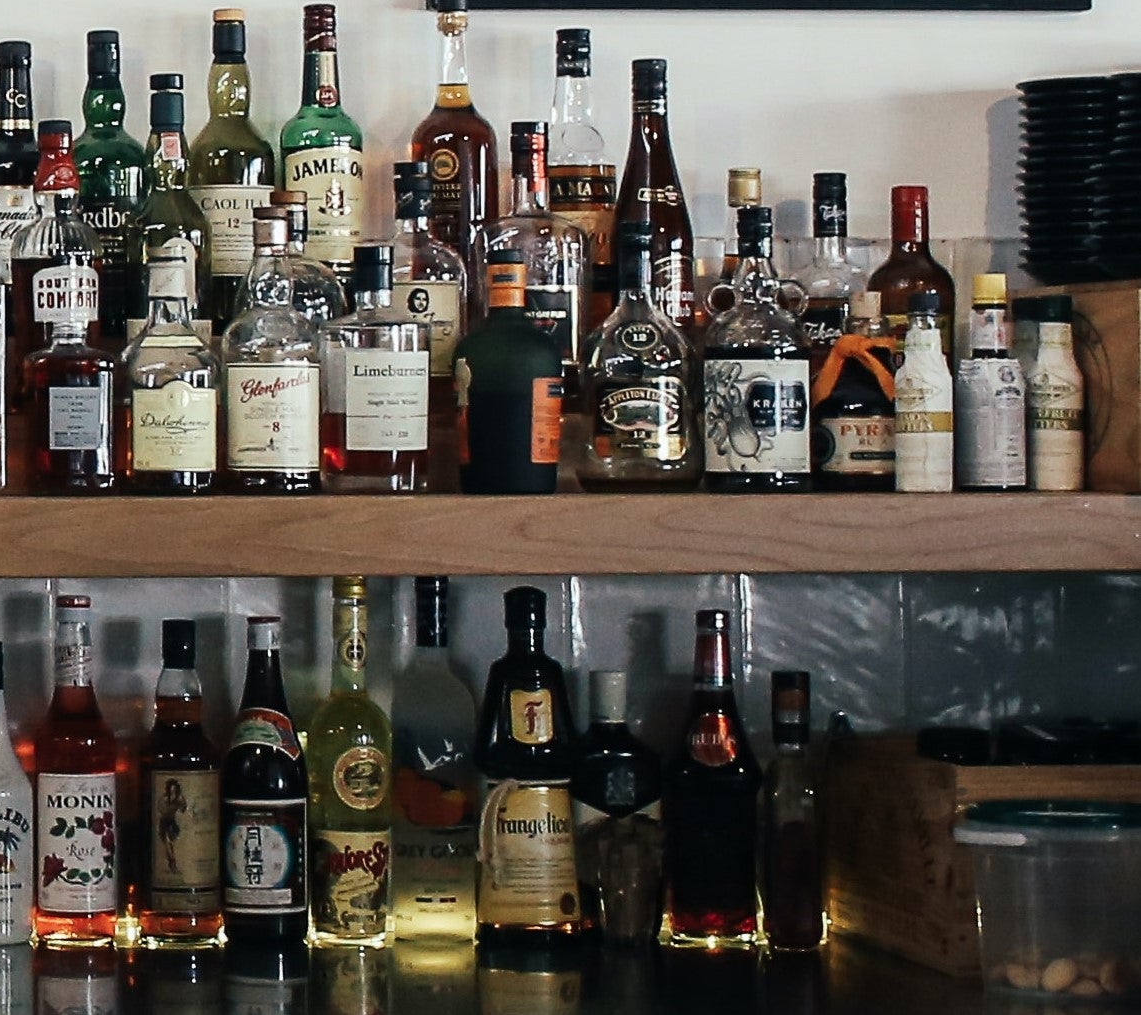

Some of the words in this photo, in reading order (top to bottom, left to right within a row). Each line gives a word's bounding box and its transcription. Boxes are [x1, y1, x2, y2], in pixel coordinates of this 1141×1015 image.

[292, 157, 363, 181] JAMEON
[201, 197, 240, 211] CAOL
[227, 218, 240, 229] 12
[38, 277, 97, 289] SOUTERN
[46, 794, 113, 809] MONIN
